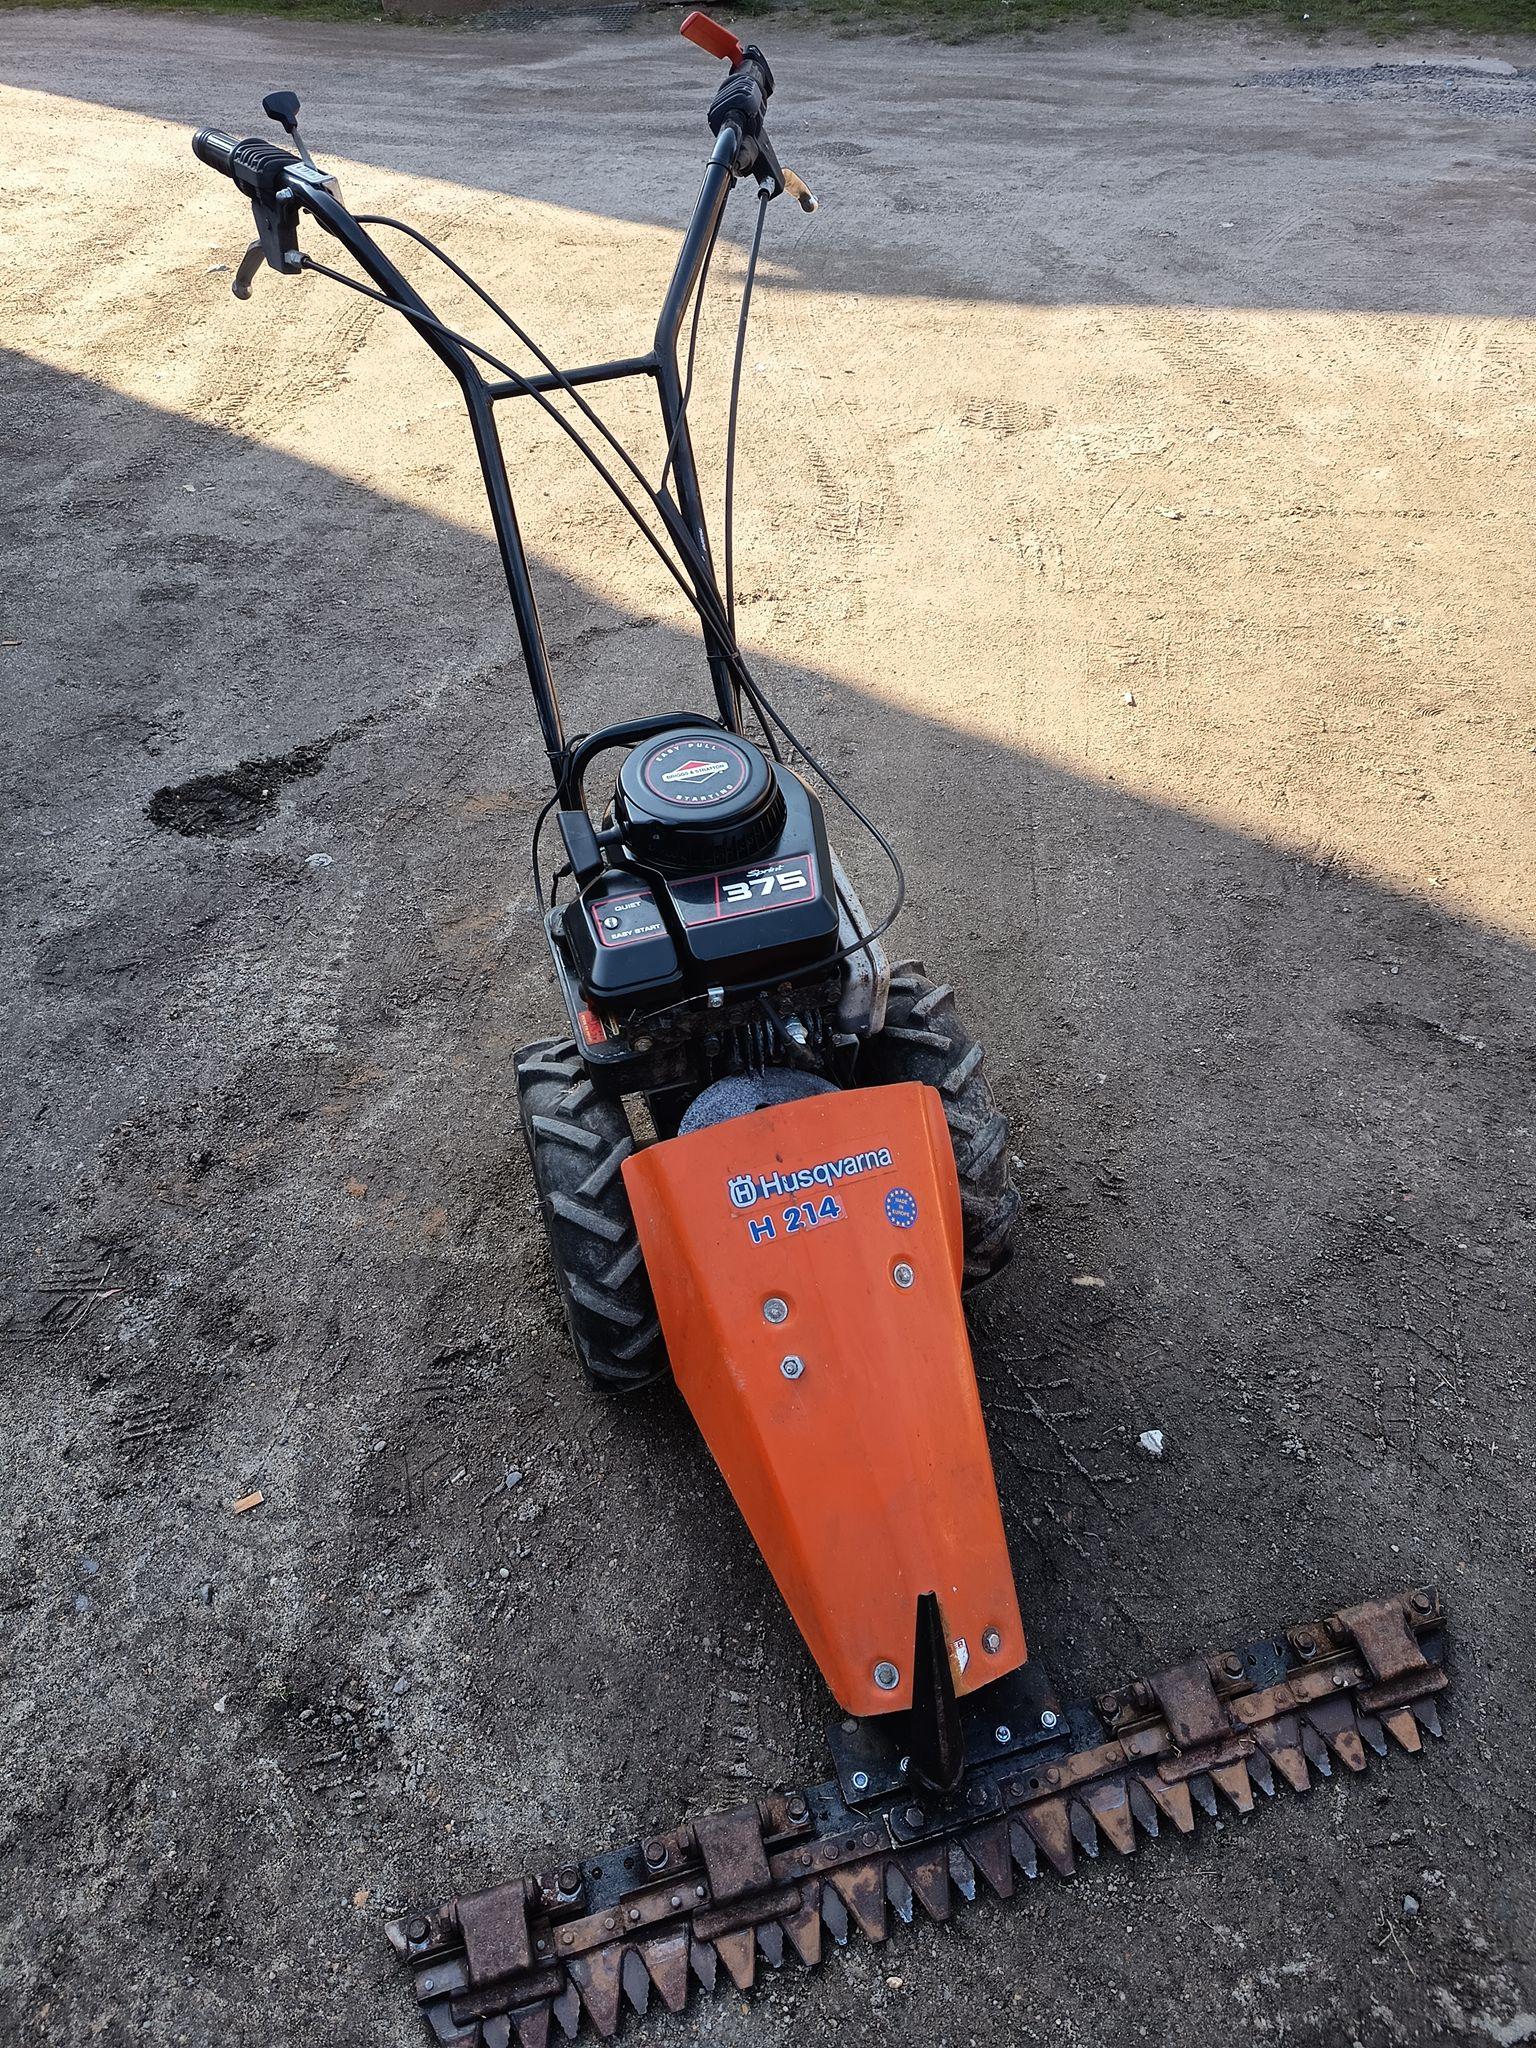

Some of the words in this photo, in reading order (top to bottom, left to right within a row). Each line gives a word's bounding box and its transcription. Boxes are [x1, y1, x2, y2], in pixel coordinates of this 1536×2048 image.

[656, 745, 681, 762] EASY
[688, 742, 717, 751] PULL
[666, 771, 689, 780] BRIGGS
[695, 764, 725, 774] STRATTON
[675, 784, 734, 802] STARTING
[746, 864, 784, 879] Sprint
[722, 869, 807, 903] 375
[614, 901, 642, 912] QUIET
[611, 929, 633, 940] EASY
[634, 923, 661, 934] START
[758, 1147, 893, 1200] Husqvarna
[748, 1216, 776, 1244] H
[782, 1195, 841, 1233] 214
[892, 1209, 910, 1217] EUROPE
